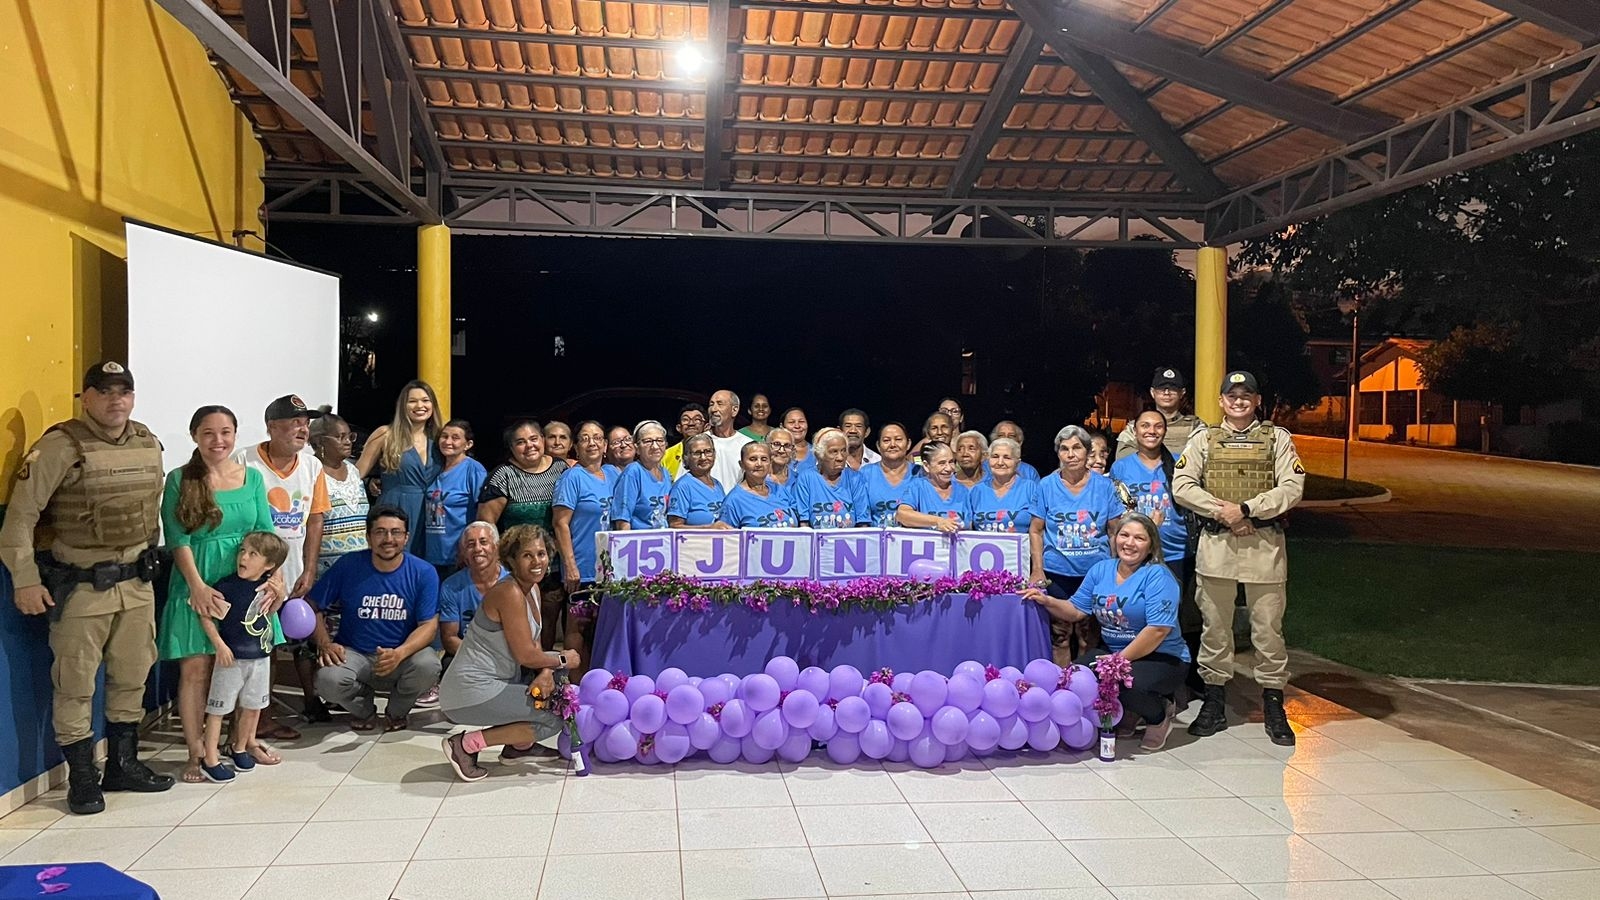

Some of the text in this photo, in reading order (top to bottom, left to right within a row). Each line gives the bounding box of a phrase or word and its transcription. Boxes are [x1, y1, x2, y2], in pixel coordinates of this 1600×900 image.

[976, 509, 1019, 523] SCFV
[1054, 508, 1099, 524] SCFV
[617, 538, 665, 578] 15
[362, 593, 404, 609] CHEGOU
[371, 607, 407, 620] A HORA
